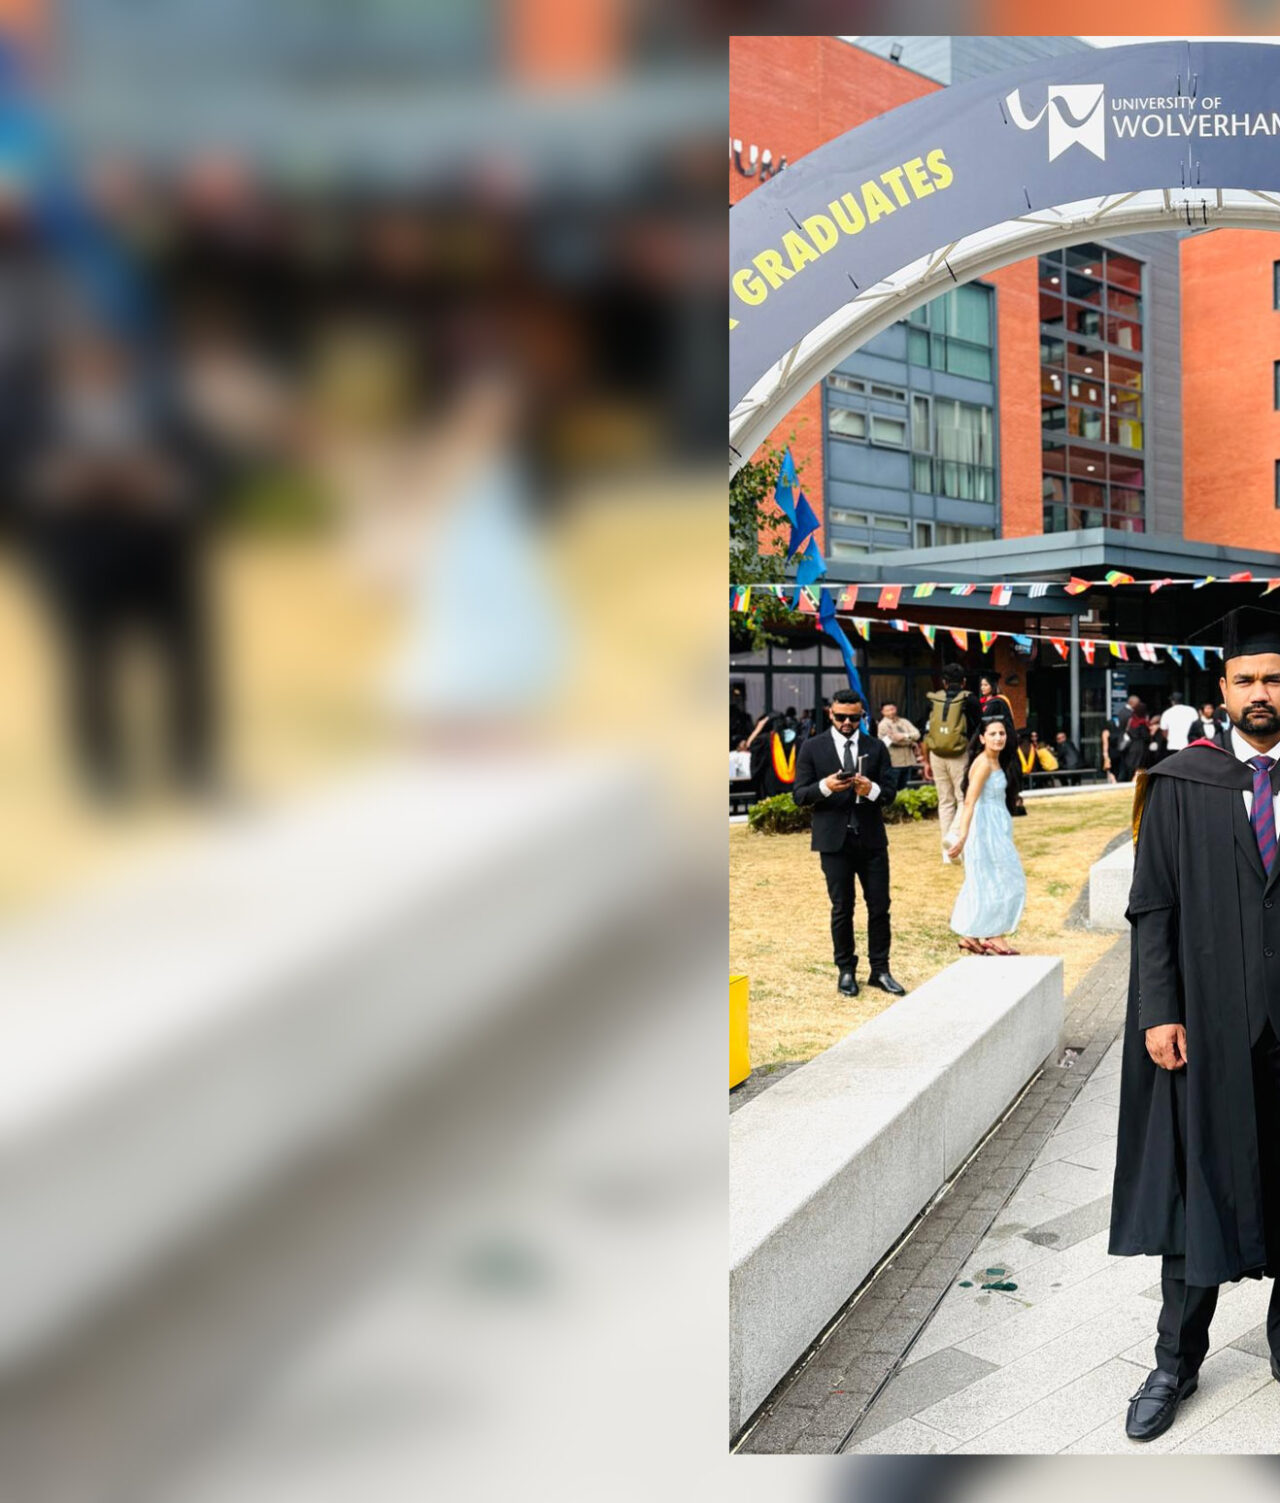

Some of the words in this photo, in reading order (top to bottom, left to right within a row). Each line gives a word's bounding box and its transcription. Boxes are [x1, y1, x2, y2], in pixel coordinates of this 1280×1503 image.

[1111, 96, 1197, 111] UNIVERSITY
[1201, 97, 1222, 110] OF
[731, 148, 954, 306] GRADUATES
